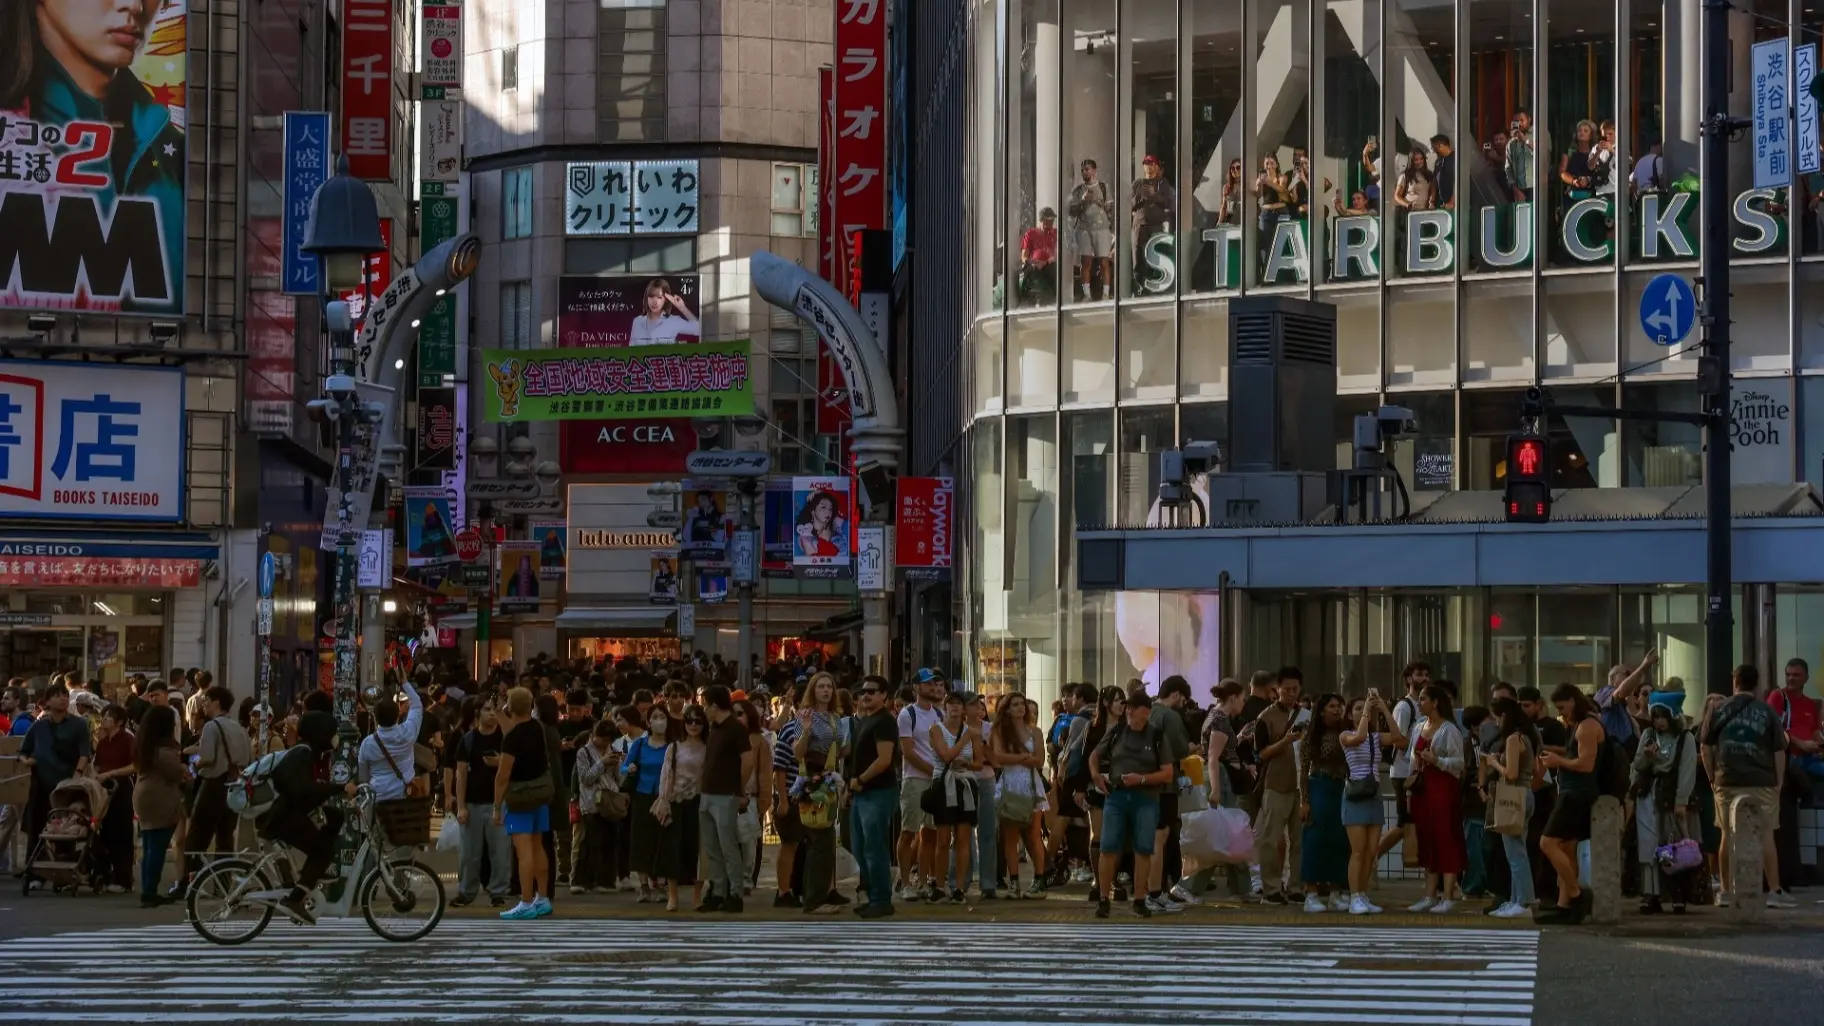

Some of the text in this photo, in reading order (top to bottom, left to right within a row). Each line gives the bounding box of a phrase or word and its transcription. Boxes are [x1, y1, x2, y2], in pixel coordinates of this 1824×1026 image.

[839, 0, 879, 196] カラオケ
[1757, 76, 1767, 129] Shibuya
[1767, 52, 1785, 176] 渋谷駅前
[56, 122, 111, 187] 2
[603, 167, 696, 195] れいわ
[571, 202, 696, 231] クリニック
[1145, 189, 1779, 293] STARBUCKS
[581, 332, 627, 342] DA VINCI
[802, 294, 864, 411] 渋谷センター街
[523, 353, 748, 397] 全国地域安全運動実施中
[0, 394, 141, 482] 店
[597, 426, 675, 442] AC CEA
[1743, 420, 1760, 431] the
[53, 490, 159, 506] BOOKS TAISEIDO
